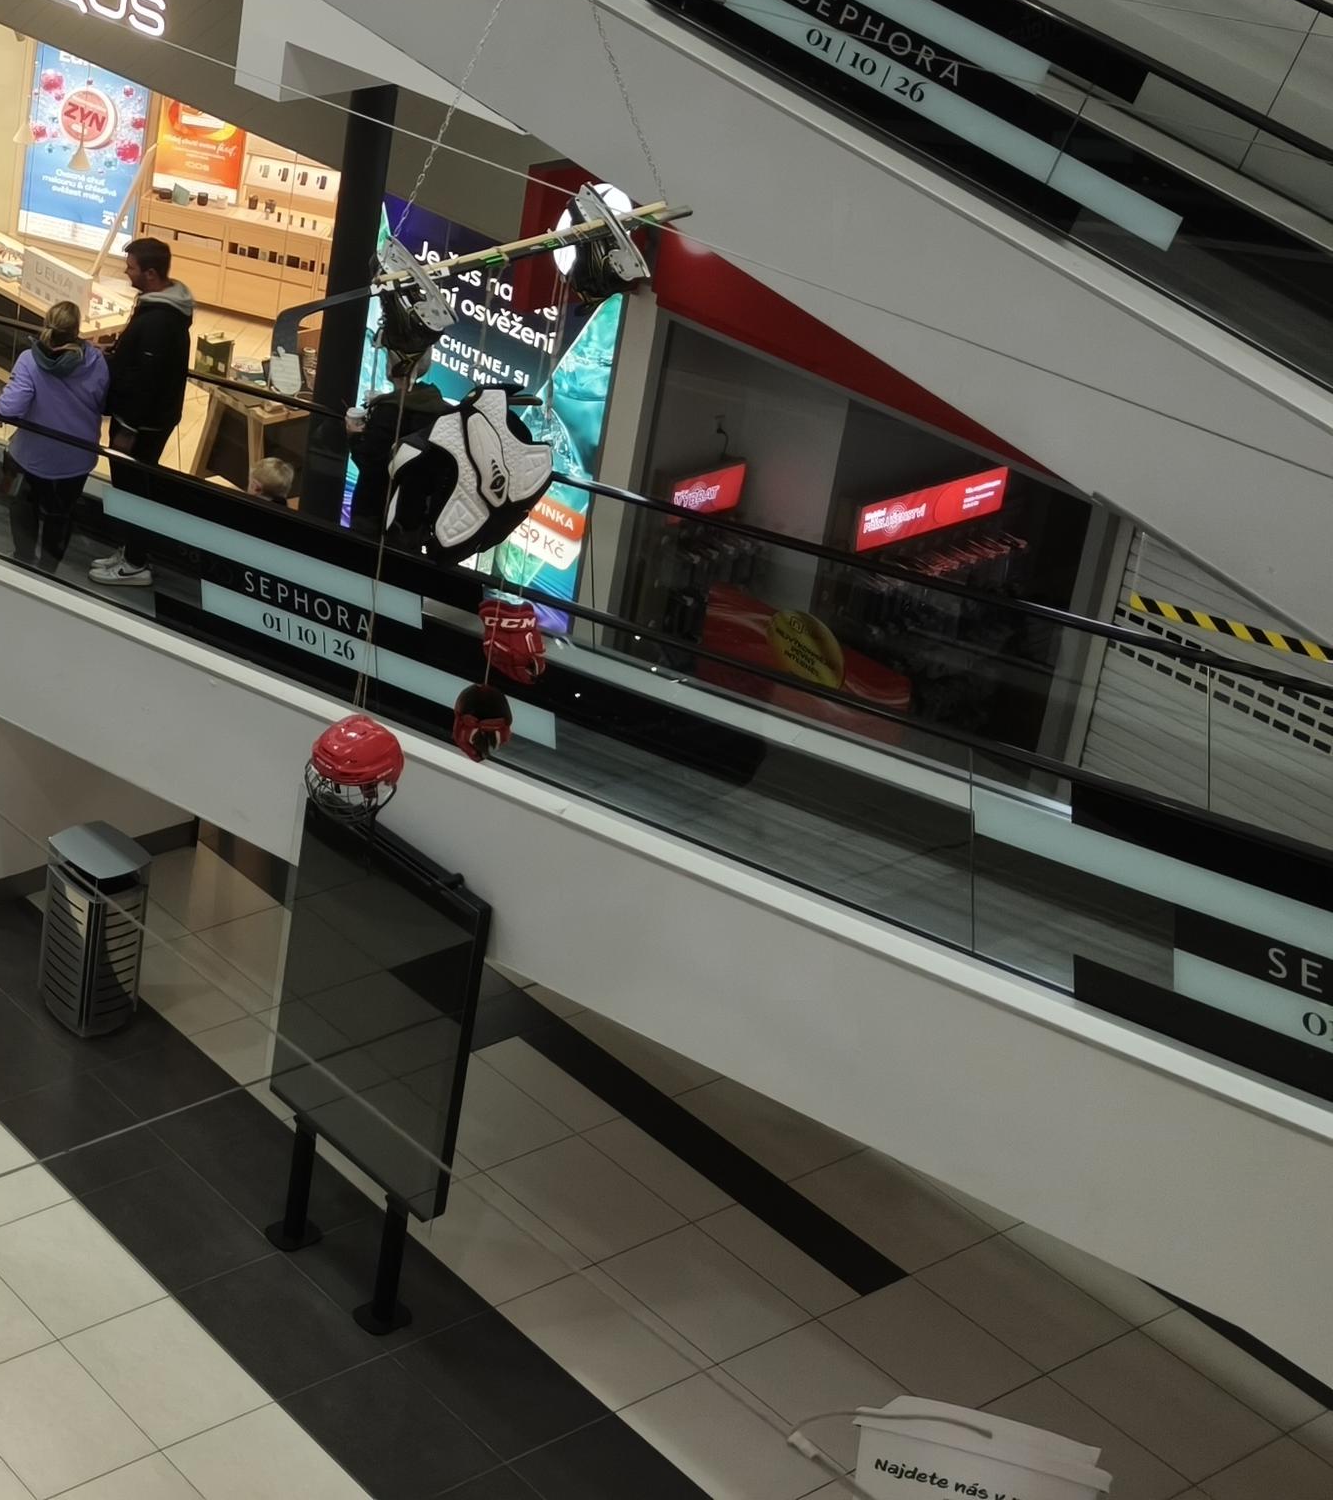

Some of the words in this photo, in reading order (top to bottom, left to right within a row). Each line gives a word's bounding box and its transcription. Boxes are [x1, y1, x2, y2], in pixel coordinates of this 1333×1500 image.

[806, 28, 832, 53] 01
[849, 51, 876, 76] 10
[893, 76, 929, 103] 26
[63, 102, 106, 132] ZYN
[415, 240, 441, 265] Je
[461, 298, 557, 355] osvěžení
[431, 349, 470, 377] BLUE
[439, 334, 511, 376] CHUTNEJ
[513, 368, 530, 388] SI
[533, 501, 575, 531] VINKA
[512, 522, 541, 544] 59
[542, 535, 567, 560] Kč
[244, 571, 372, 638] SEPHORA
[484, 616, 536, 629] CCM
[262, 612, 282, 633] 01
[297, 625, 317, 646] 10
[333, 639, 355, 661] 26
[874, 1458, 950, 1490] Najdete
[954, 1482, 989, 1500] nás
